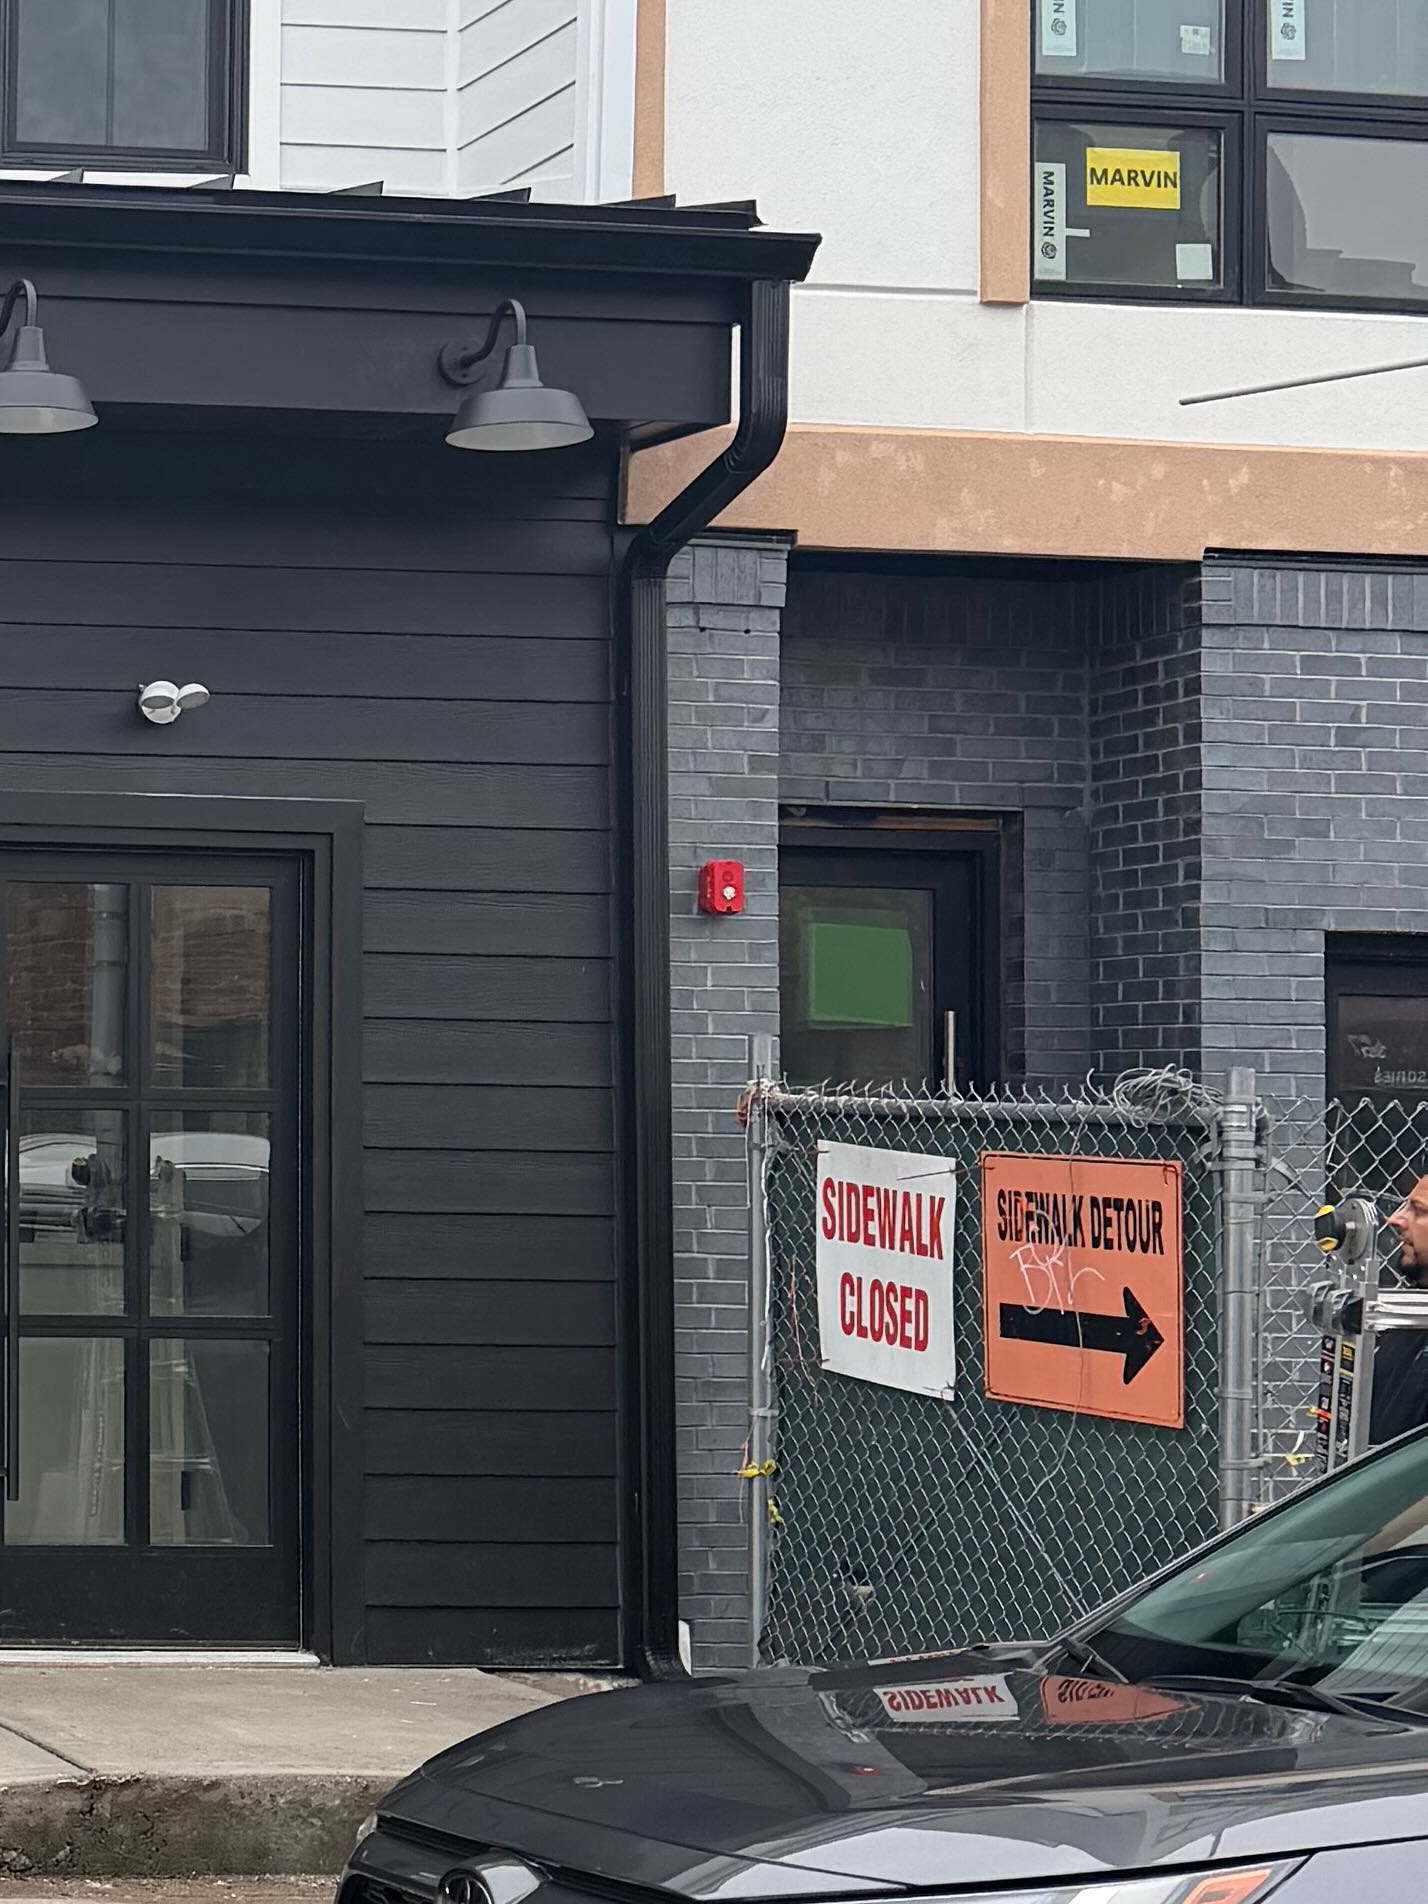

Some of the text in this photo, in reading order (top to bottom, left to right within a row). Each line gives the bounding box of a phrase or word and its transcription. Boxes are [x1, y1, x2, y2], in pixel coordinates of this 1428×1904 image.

[1041, 170, 1055, 239] MARVIN
[1088, 166, 1178, 190] MARVIN
[821, 1176, 945, 1260] SIDEWALK
[996, 1188, 1165, 1256] SIDEWALK DETOUR
[839, 1271, 929, 1353] CLOSED
